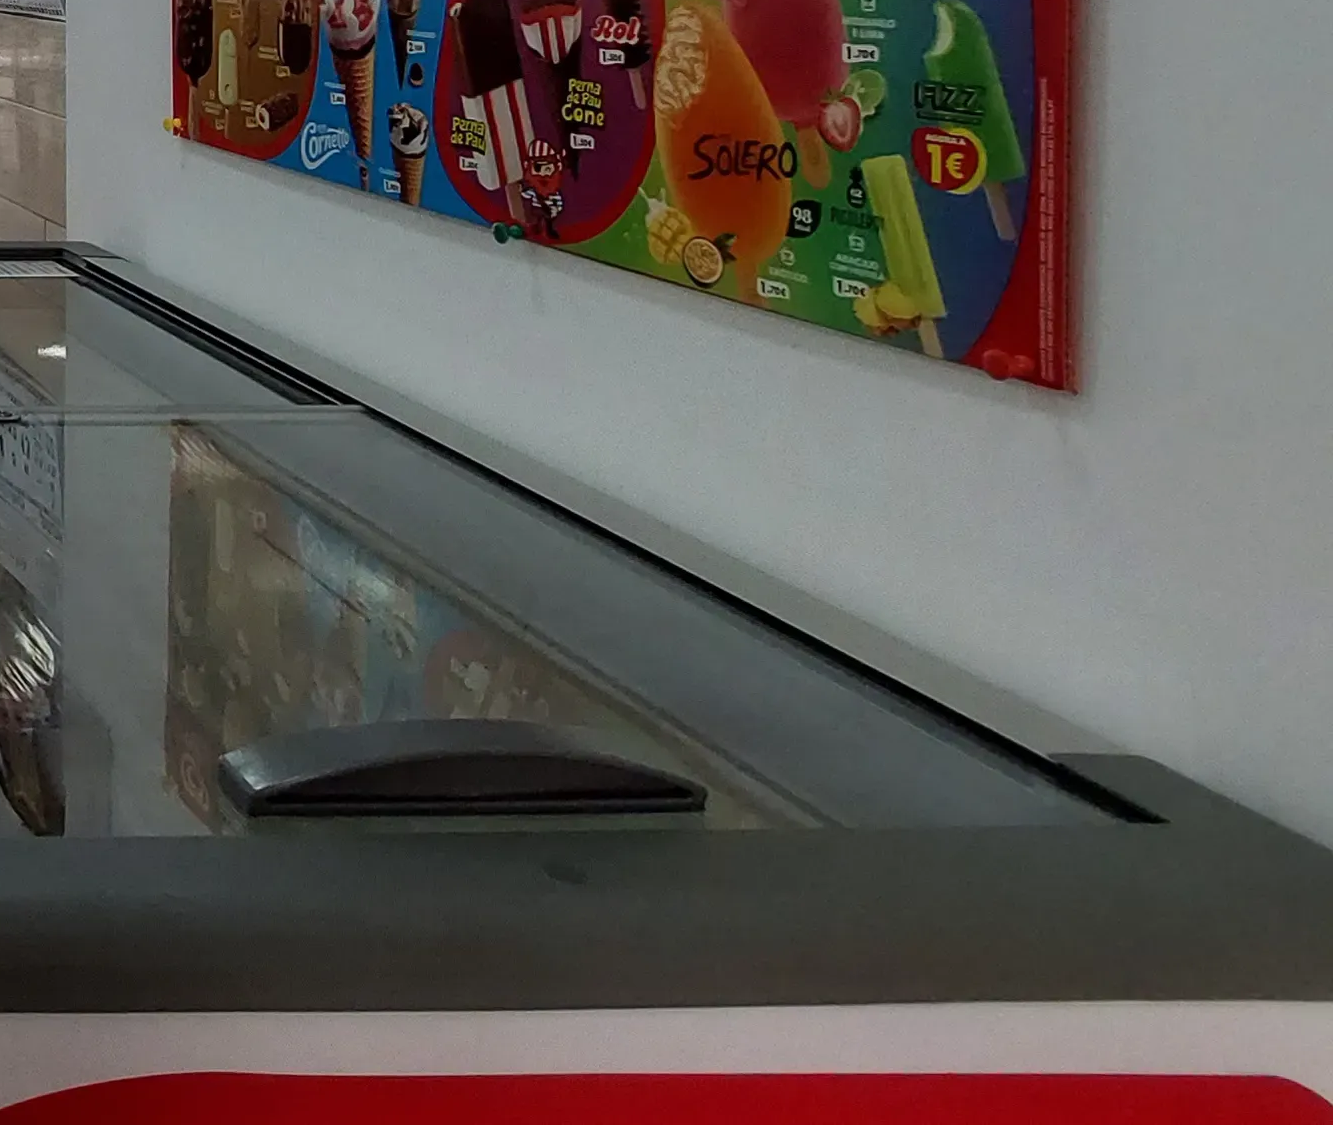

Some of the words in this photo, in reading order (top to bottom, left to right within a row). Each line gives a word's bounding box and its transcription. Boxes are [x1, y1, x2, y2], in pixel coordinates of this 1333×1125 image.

[591, 15, 641, 44] Rol
[561, 103, 605, 127] Cone
[580, 92, 602, 109] Pau
[301, 122, 350, 170] Cornetto
[688, 133, 799, 182] SOLERO
[926, 143, 965, 184] 1€
[792, 206, 813, 224] 98
